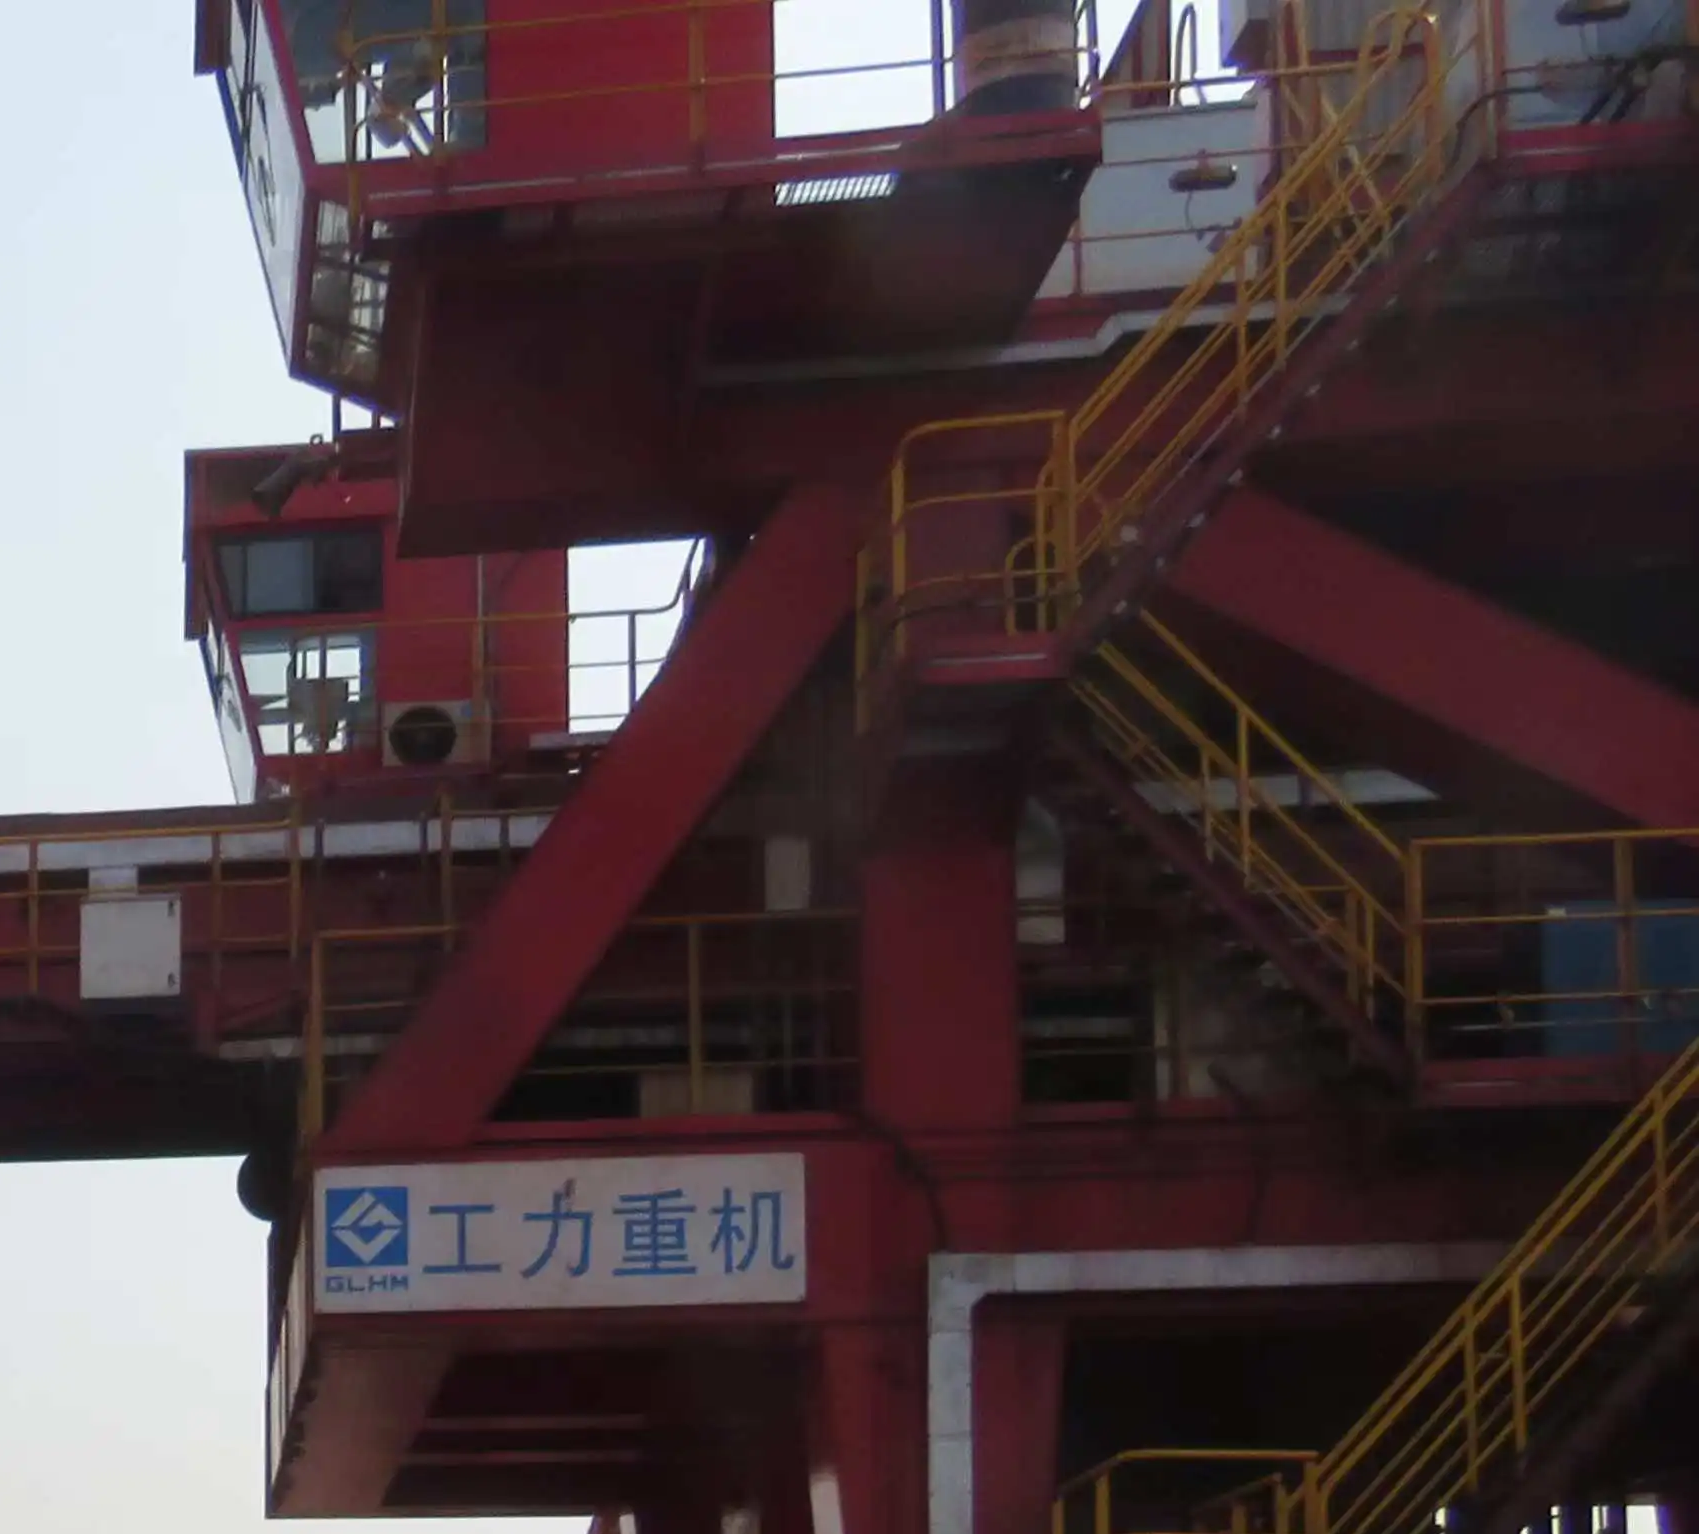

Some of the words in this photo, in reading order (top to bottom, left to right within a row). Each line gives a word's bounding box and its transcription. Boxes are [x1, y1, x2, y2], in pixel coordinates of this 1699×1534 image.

[423, 1178, 794, 1278] 工力重机
[324, 1274, 410, 1294] GLHM
